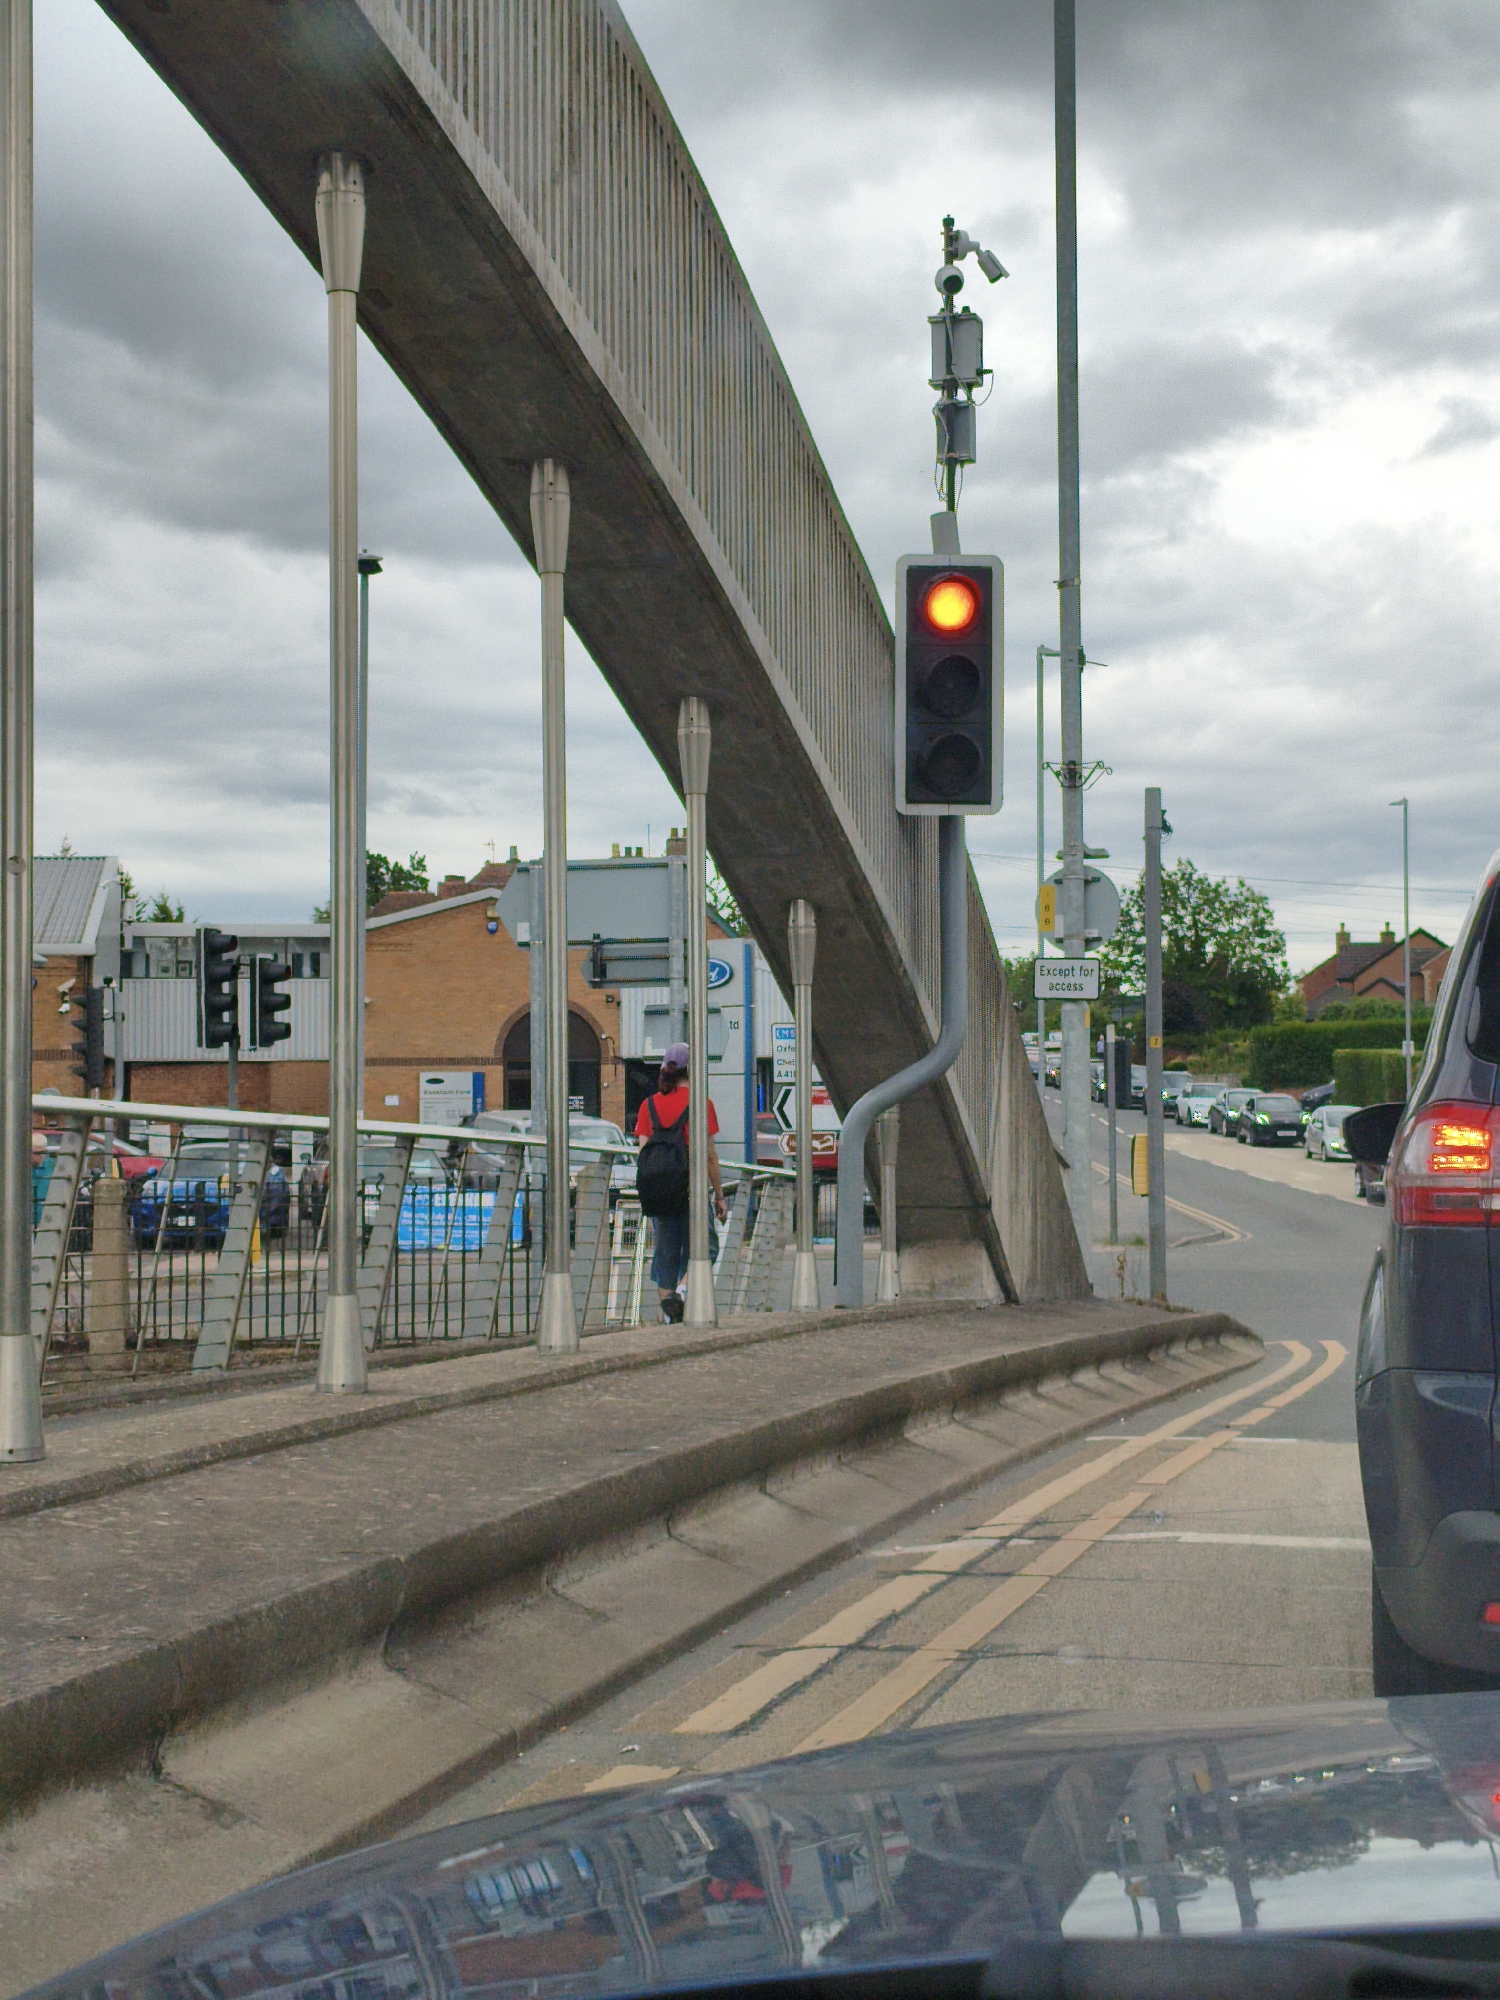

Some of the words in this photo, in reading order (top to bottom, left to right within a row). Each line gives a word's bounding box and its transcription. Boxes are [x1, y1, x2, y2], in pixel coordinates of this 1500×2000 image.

[1039, 965, 1075, 978] Except
[1079, 965, 1095, 977] for
[1048, 982, 1084, 991] access
[776, 1044, 795, 1053] Oxfo
